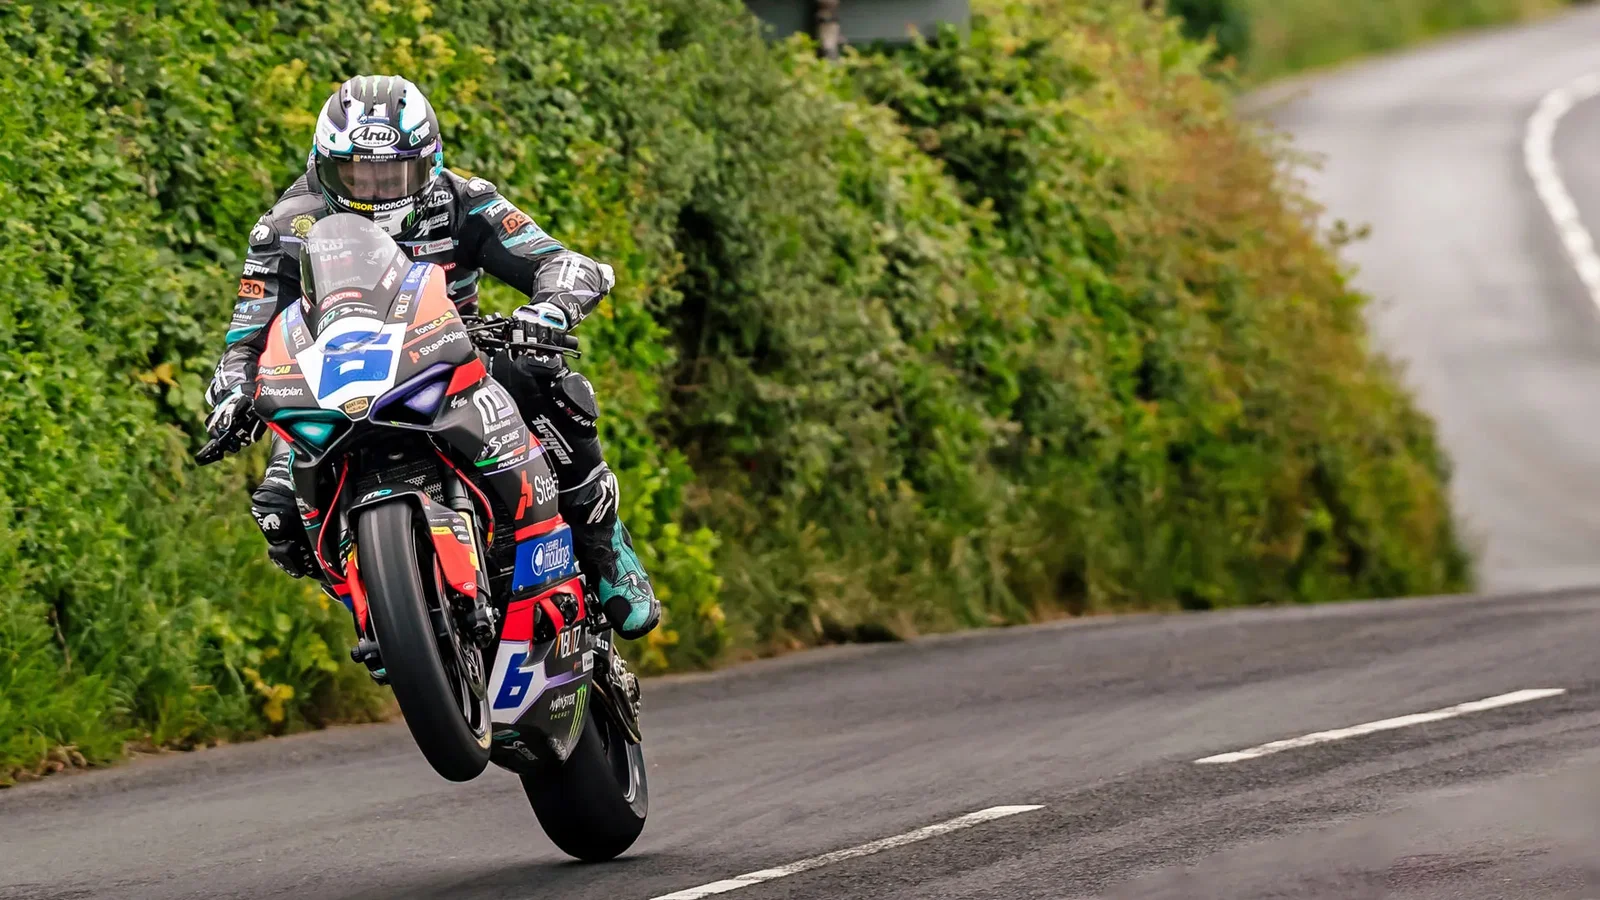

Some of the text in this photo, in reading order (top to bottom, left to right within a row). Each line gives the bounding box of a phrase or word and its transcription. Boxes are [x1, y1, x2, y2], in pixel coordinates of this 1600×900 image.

[353, 126, 394, 142] Arai
[317, 330, 394, 401] 6
[492, 651, 535, 710] 6
[549, 692, 576, 711] MONSTER
